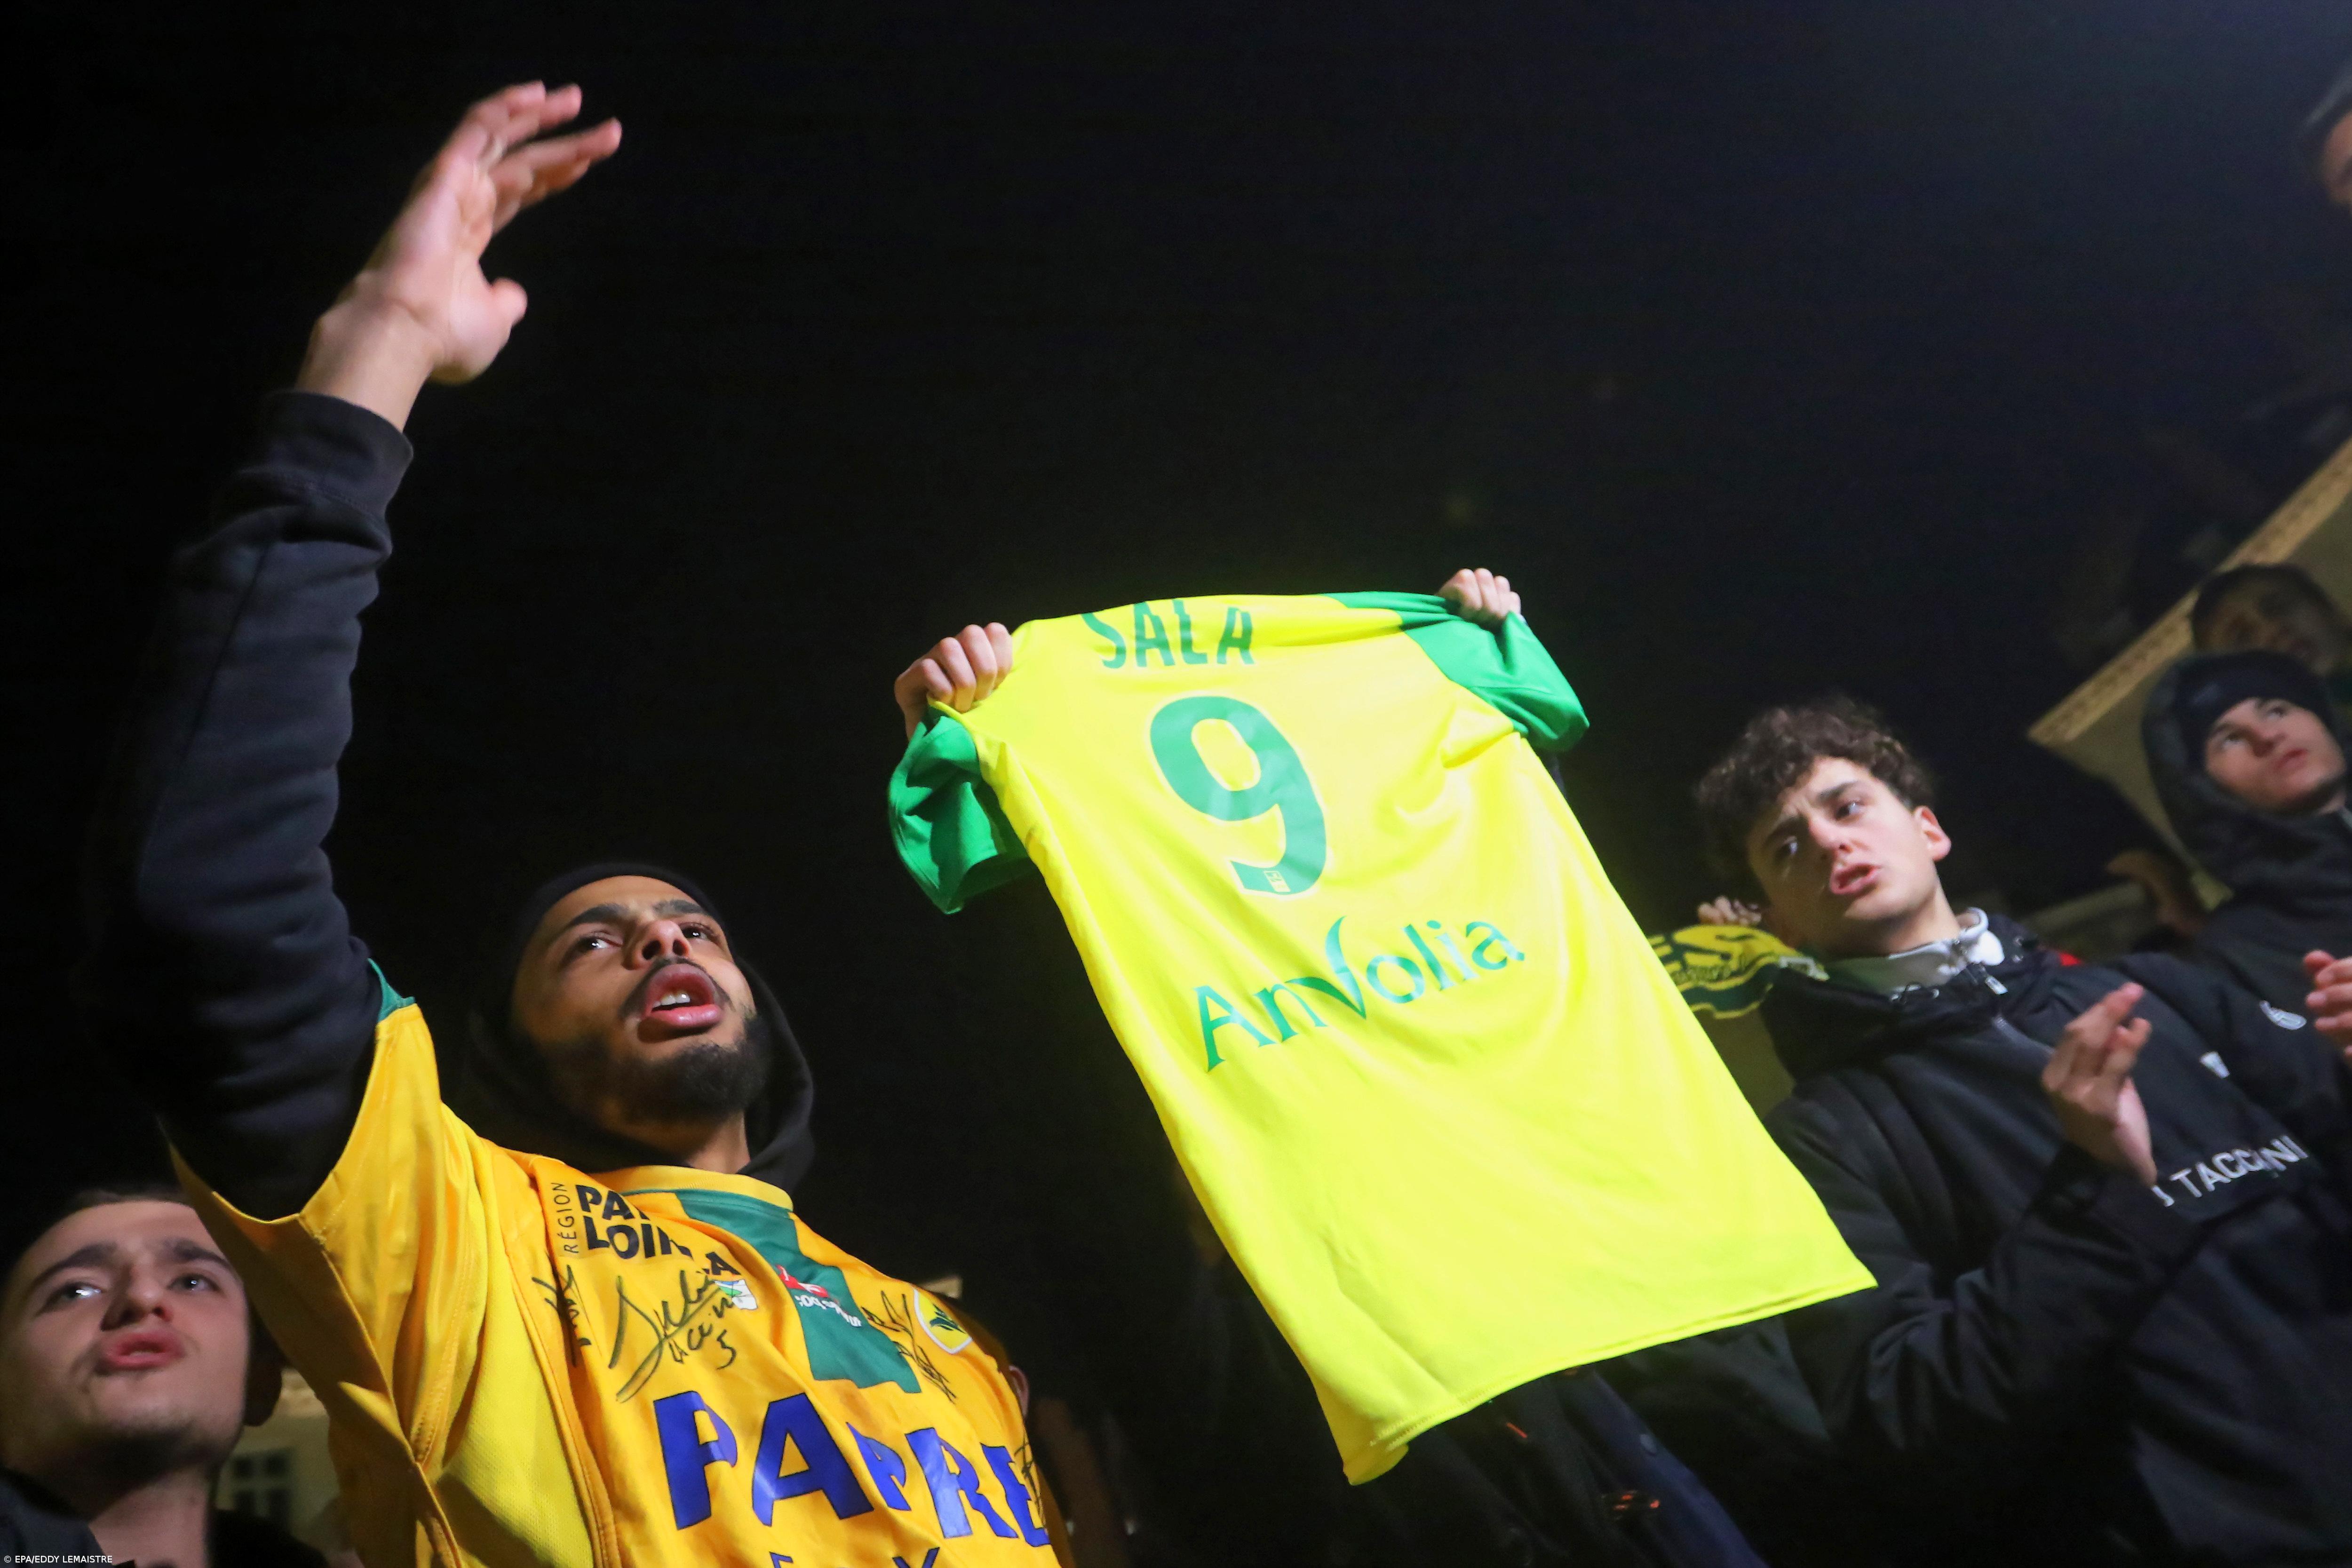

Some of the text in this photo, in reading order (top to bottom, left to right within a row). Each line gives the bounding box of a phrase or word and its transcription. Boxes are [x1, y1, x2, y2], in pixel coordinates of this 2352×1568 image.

[1081, 598, 1255, 669] SALA
[1150, 695, 1327, 895] 9
[1193, 915, 1525, 1073] AnVolia
[552, 1182, 579, 1254] RÉGION
